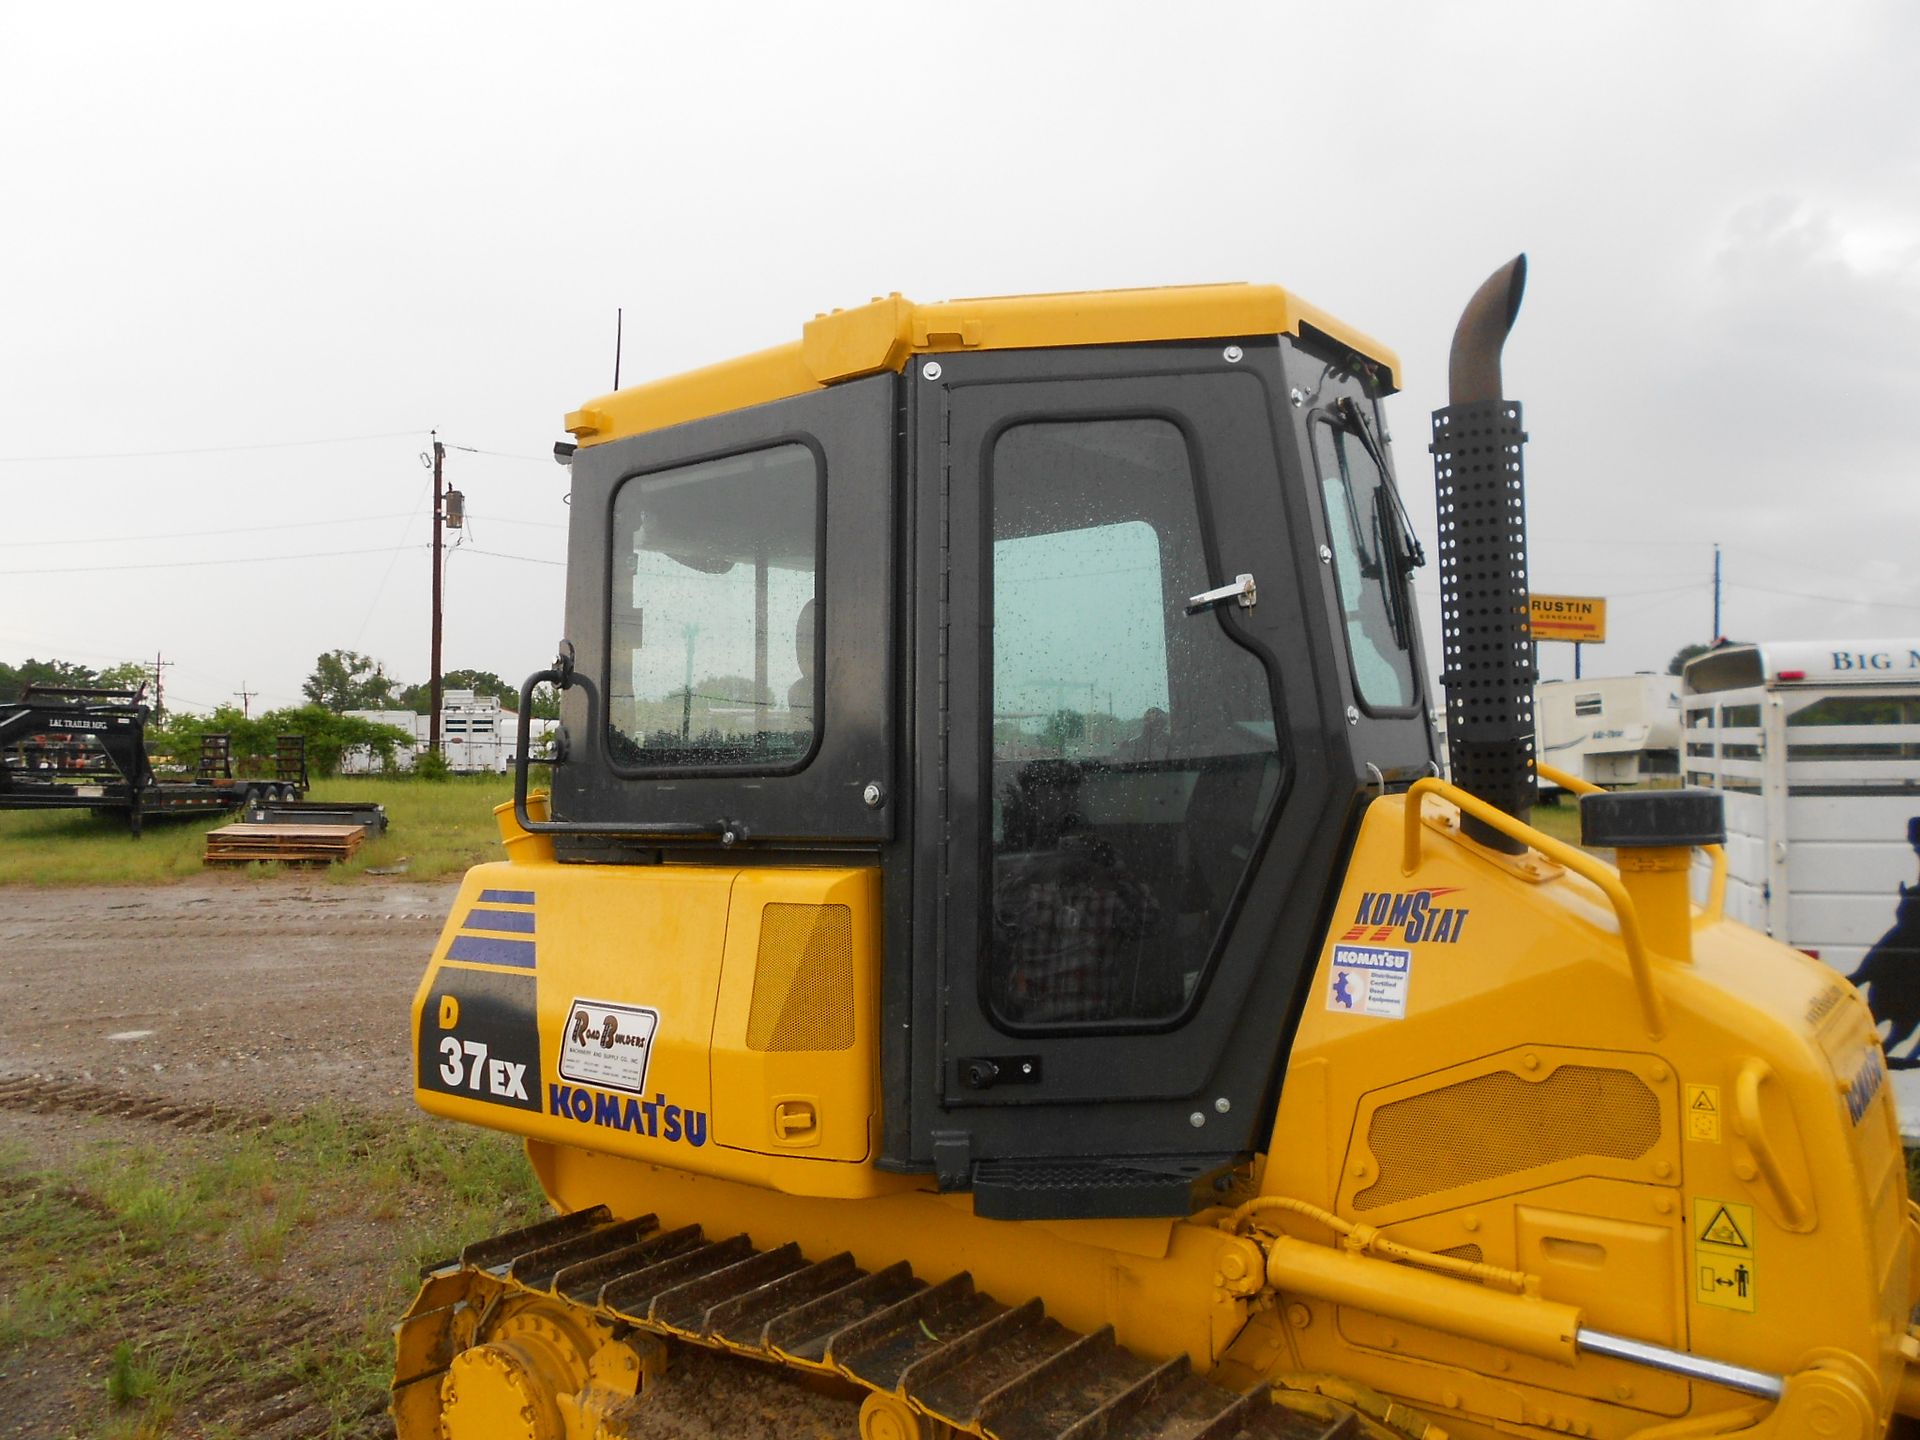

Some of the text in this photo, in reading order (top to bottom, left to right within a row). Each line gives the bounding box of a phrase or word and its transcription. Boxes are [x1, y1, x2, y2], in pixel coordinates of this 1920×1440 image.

[1531, 600, 1592, 613] RUSTIN
[1831, 652, 1892, 670] BIG
[64, 720, 91, 729] TRAILER
[1354, 891, 1469, 943] KOMSTAT
[1337, 950, 1405, 968] KOMATSU
[439, 995, 459, 1030] D
[600, 1014, 645, 1049] BUILDERS
[549, 1083, 707, 1147] KOMATSU
